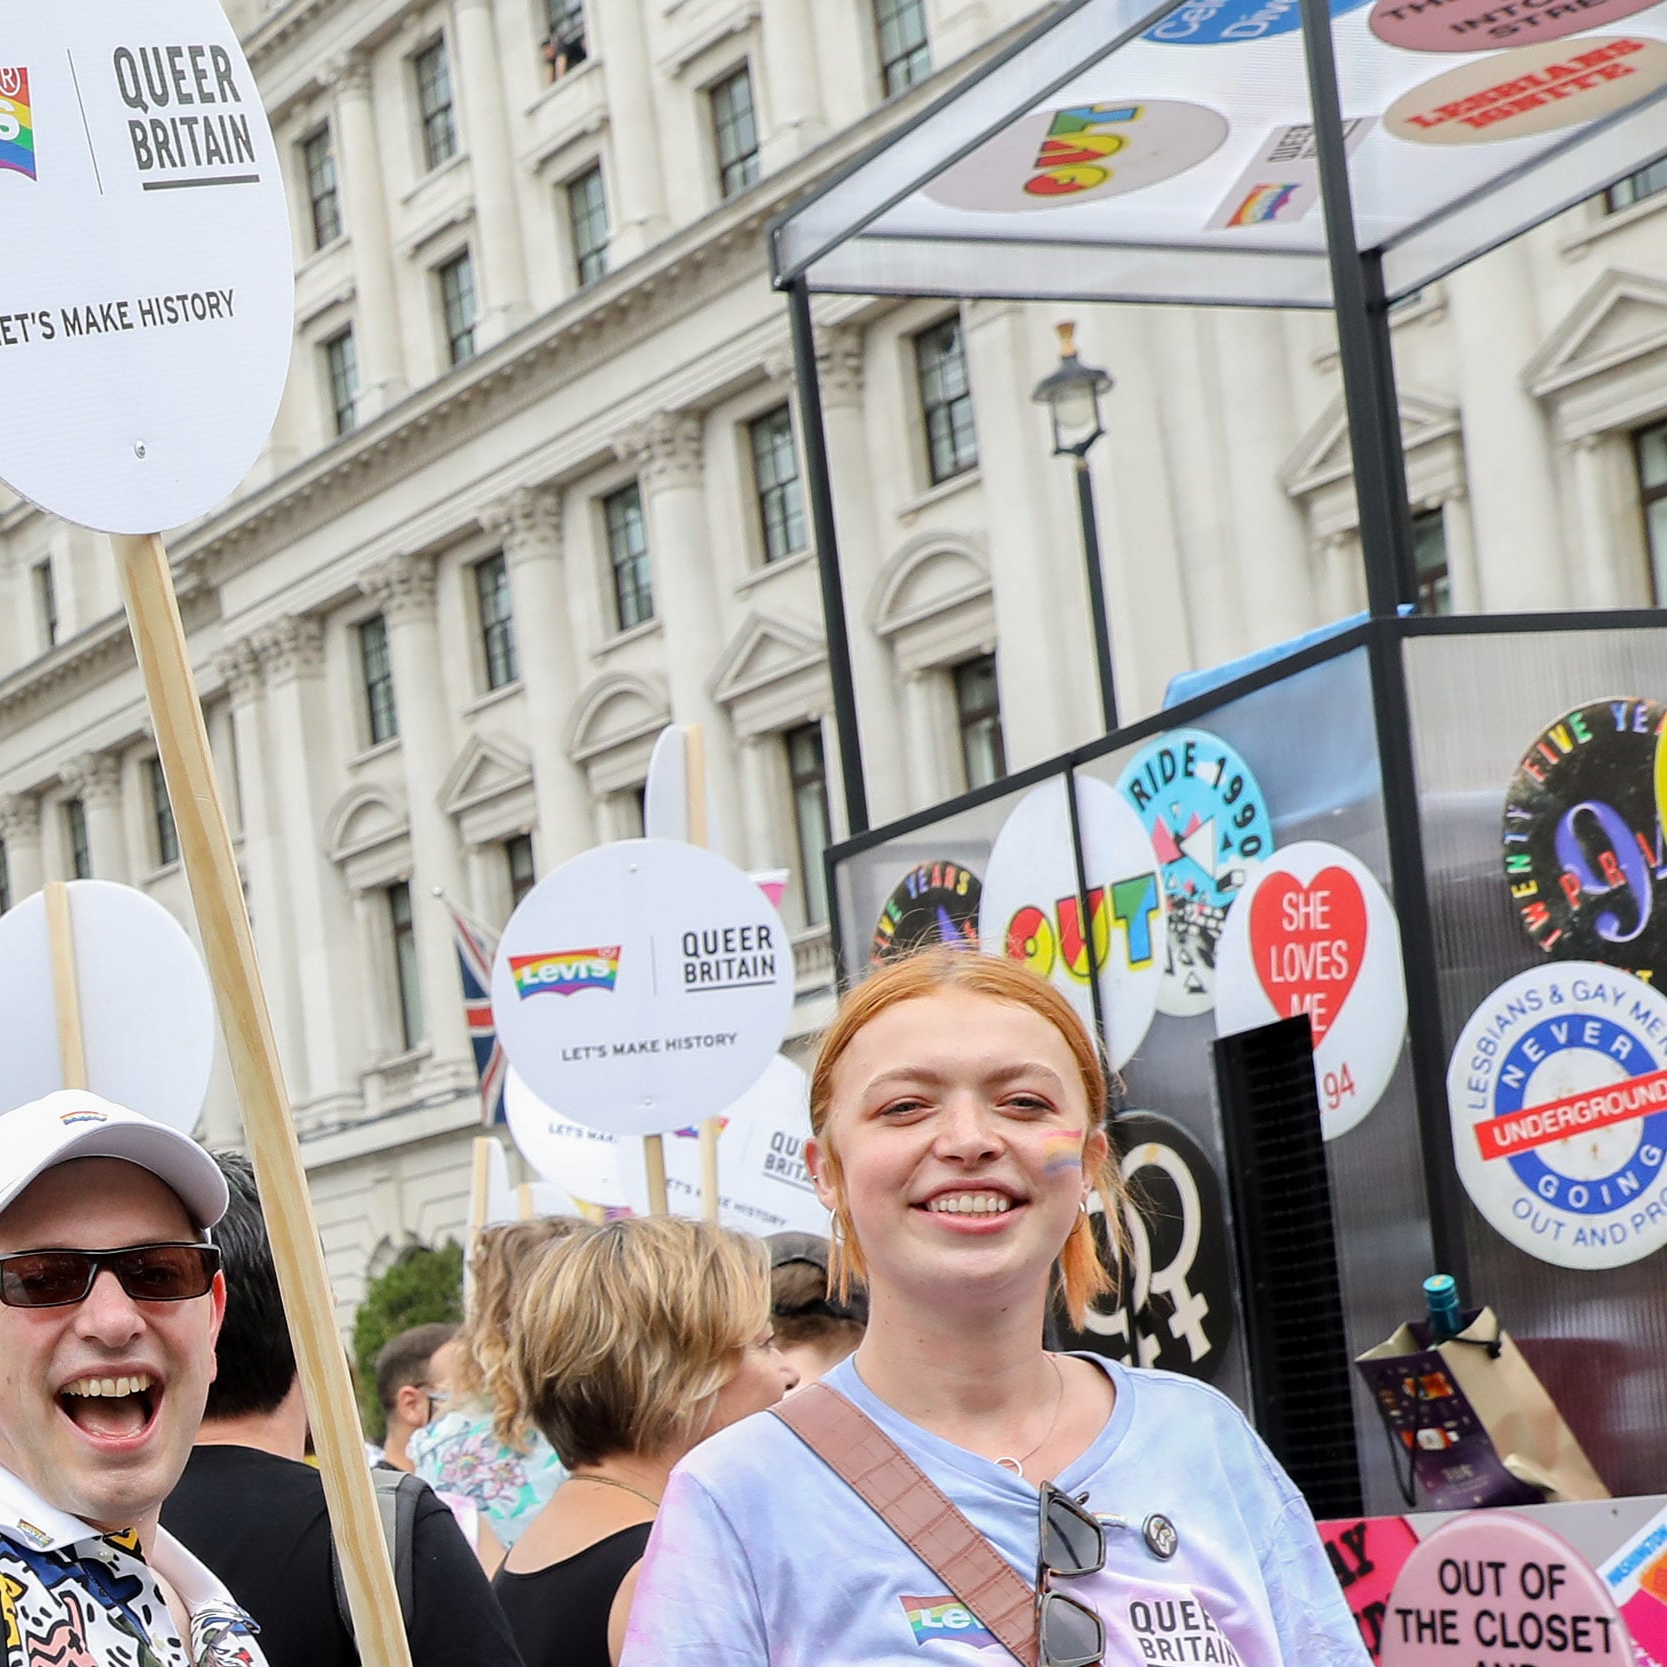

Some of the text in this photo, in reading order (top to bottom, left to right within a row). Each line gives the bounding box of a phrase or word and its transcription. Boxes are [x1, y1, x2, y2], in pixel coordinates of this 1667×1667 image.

[112, 44, 242, 114] QUEER
[1404, 38, 1646, 129] LESBIANS
[1459, 62, 1638, 129] IGNITE
[128, 113, 257, 171] BRITAIN
[1023, 105, 1142, 196] OUT
[62, 300, 134, 338] MAKE
[140, 289, 236, 328] HISTORY
[1522, 711, 1593, 783] FIVE
[1129, 742, 1262, 858] RIDE 1990
[905, 863, 971, 899] YEARS
[1503, 804, 1563, 953] TWENTY
[1558, 831, 1658, 911] PRI
[1006, 872, 1160, 985] OUT
[1281, 890, 1332, 931] SHE
[681, 924, 774, 959] QUEER
[684, 954, 776, 985] BRITAIN
[1269, 939, 1350, 983] LOVES
[561, 1032, 738, 1062] LET'S MAKE HISTORY
[1467, 988, 1545, 1111] LESBIANS
[1550, 984, 1564, 1005] &
[1571, 978, 1627, 1007] GAY
[1501, 1020, 1635, 1090] NEVER
[1492, 1077, 1667, 1148] UNDERGROUND
[1537, 1144, 1662, 1209] GOING
[732, 1202, 788, 1227] HISTORY
[1512, 1196, 1567, 1242] OUT
[1572, 1221, 1627, 1249] AND
[1438, 1557, 1567, 1602] OUT OF
[1137, 1636, 1241, 1667] BRITAIN
[1395, 1607, 1461, 1648] THE
[1474, 1610, 1618, 1655] CLOSET
